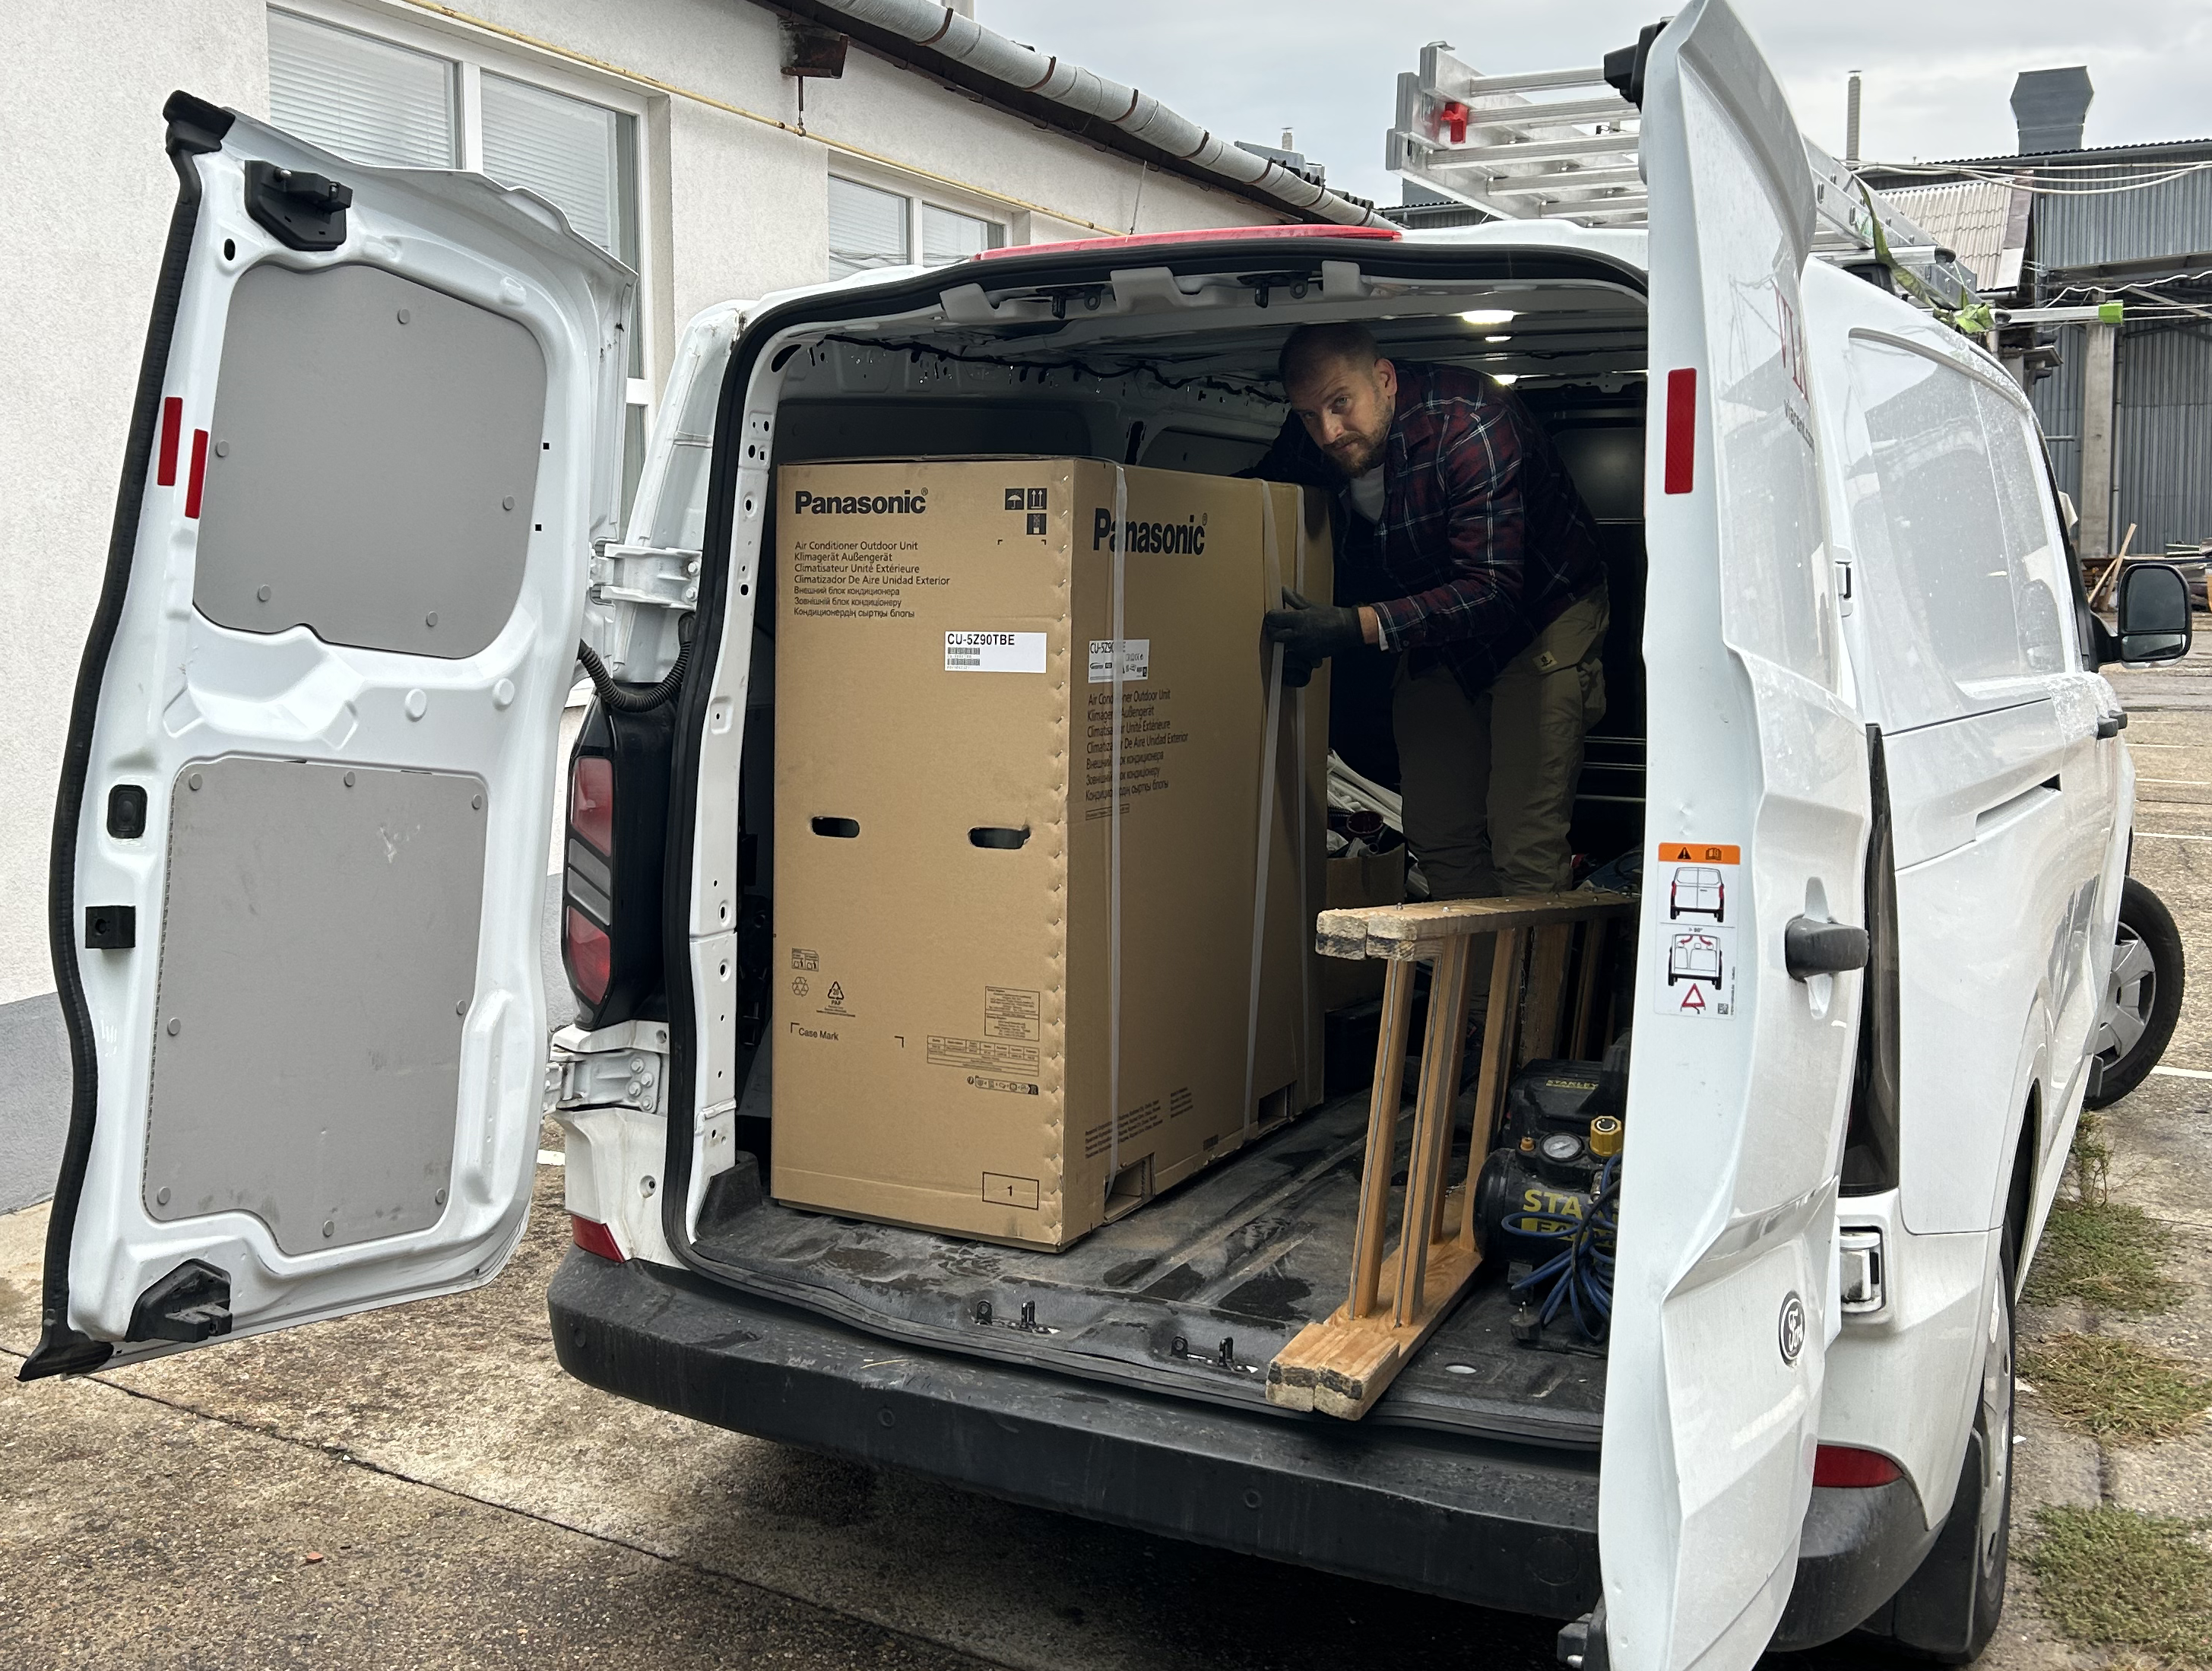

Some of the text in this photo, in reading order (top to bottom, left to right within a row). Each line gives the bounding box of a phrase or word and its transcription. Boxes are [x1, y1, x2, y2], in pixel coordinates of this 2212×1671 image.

[794, 541, 918, 550] Air Conditioner Outdoor Unit
[794, 552, 892, 563] Klimagerät Außengerät
[794, 563, 920, 573] Climatisateur Unité Extérieure
[794, 575, 950, 585] Climatizador De Aire Unidad Exterior
[828, 586, 846, 595] блок
[847, 588, 900, 597] кондиционера
[832, 597, 850, 606] блок
[947, 633, 1016, 645] CU-5Z90TBE
[1088, 693, 1098, 706] Air
[1133, 689, 1158, 702] Outdoor
[799, 1027, 839, 1041] Case Mark
[1007, 1185, 1013, 1197] 1
